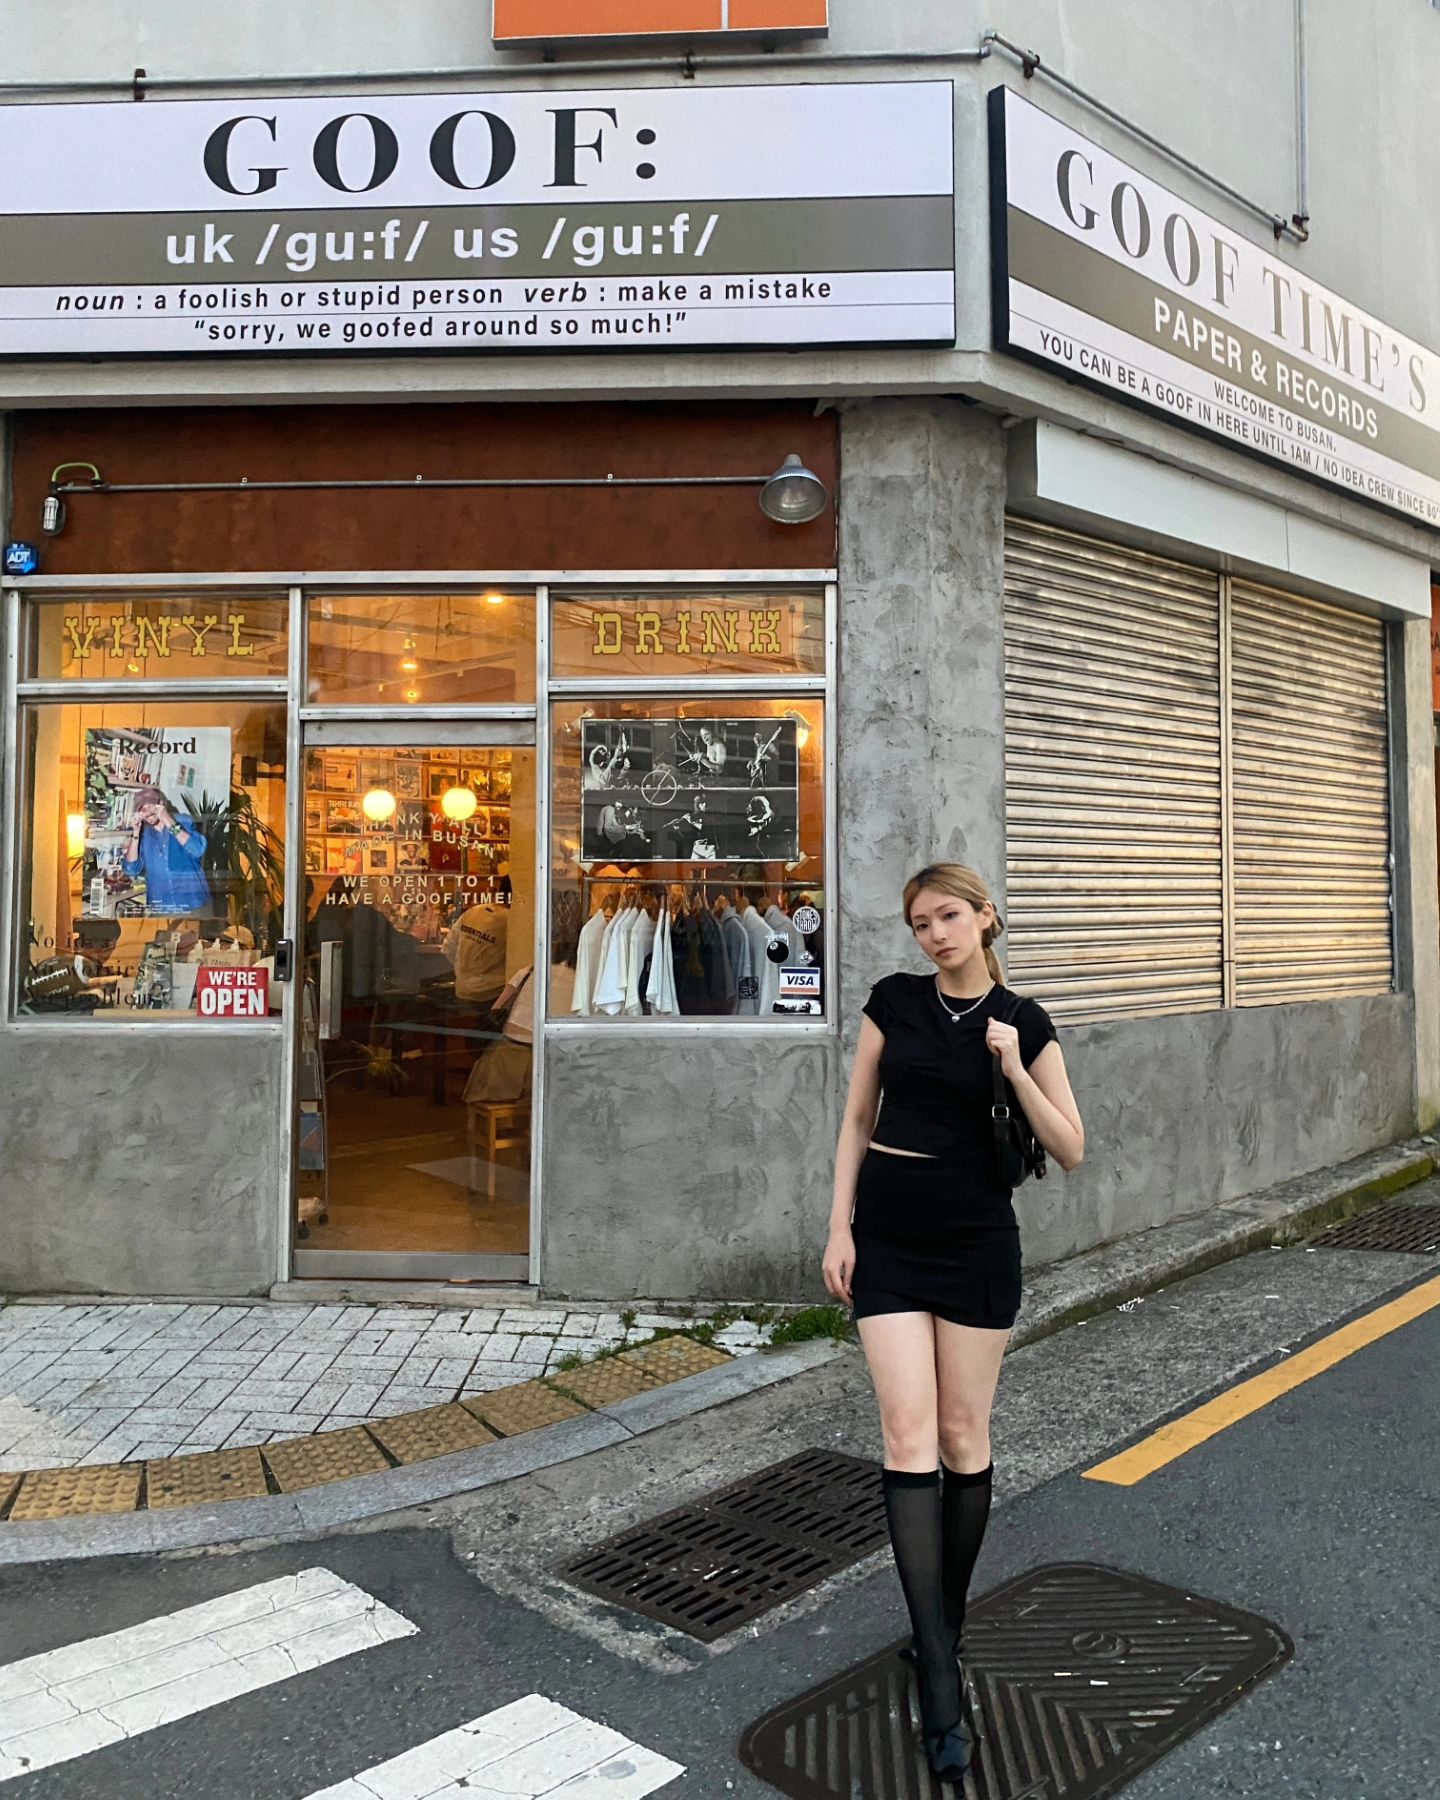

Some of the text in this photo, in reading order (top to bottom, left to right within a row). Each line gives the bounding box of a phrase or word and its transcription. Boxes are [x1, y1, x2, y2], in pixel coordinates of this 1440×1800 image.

[203, 107, 657, 196] GOOF:
[166, 212, 719, 272] uk /gu:f/ us /gu:f/
[55, 295, 124, 311] noun
[154, 294, 167, 310] a
[178, 287, 268, 309] foolish
[280, 291, 306, 308] or
[317, 284, 400, 308] stupid
[412, 288, 502, 311] person
[524, 281, 587, 303] verb
[618, 280, 687, 302] make
[699, 284, 712, 301] a
[725, 277, 831, 300] mistake
[1056, 149, 1428, 413] GOOF TIME'S
[297, 320, 331, 339] we
[342, 316, 434, 342] goofed
[445, 315, 538, 337] around
[550, 317, 579, 334] so
[1154, 297, 1378, 439] PAPER & RECORDS
[1040, 330, 1073, 361] YOU
[1080, 349, 1111, 379] CAN
[1118, 365, 1136, 389] BE
[1141, 377, 1151, 396] A
[1156, 383, 1193, 413] GOOF
[1198, 402, 1211, 422] IN
[1216, 411, 1249, 439] HERE
[1253, 426, 1287, 456] UNTIL
[1291, 444, 1311, 466] 1AM
[1323, 458, 1338, 477] NO
[1342, 466, 1365, 489] IDEA
[1368, 477, 1395, 502] CREW
[1397, 490, 1429, 514] SINCE
[1214, 381, 1337, 453] WELCOME TO BUSAN.
[7, 551, 30, 564] ADT
[64, 614, 254, 658] VINYL
[592, 610, 782, 654] DRINK
[118, 737, 196, 754] Record
[361, 812, 420, 835] THANK
[405, 829, 422, 841] IN
[432, 830, 494, 860] BUSAN
[343, 875, 494, 888] WE OPEN 1 TO 1
[325, 892, 512, 905] HAVE A GOOF TIME!
[208, 971, 257, 985] WE'RE
[787, 975, 814, 986] VISA
[201, 988, 264, 1015] OPEN
